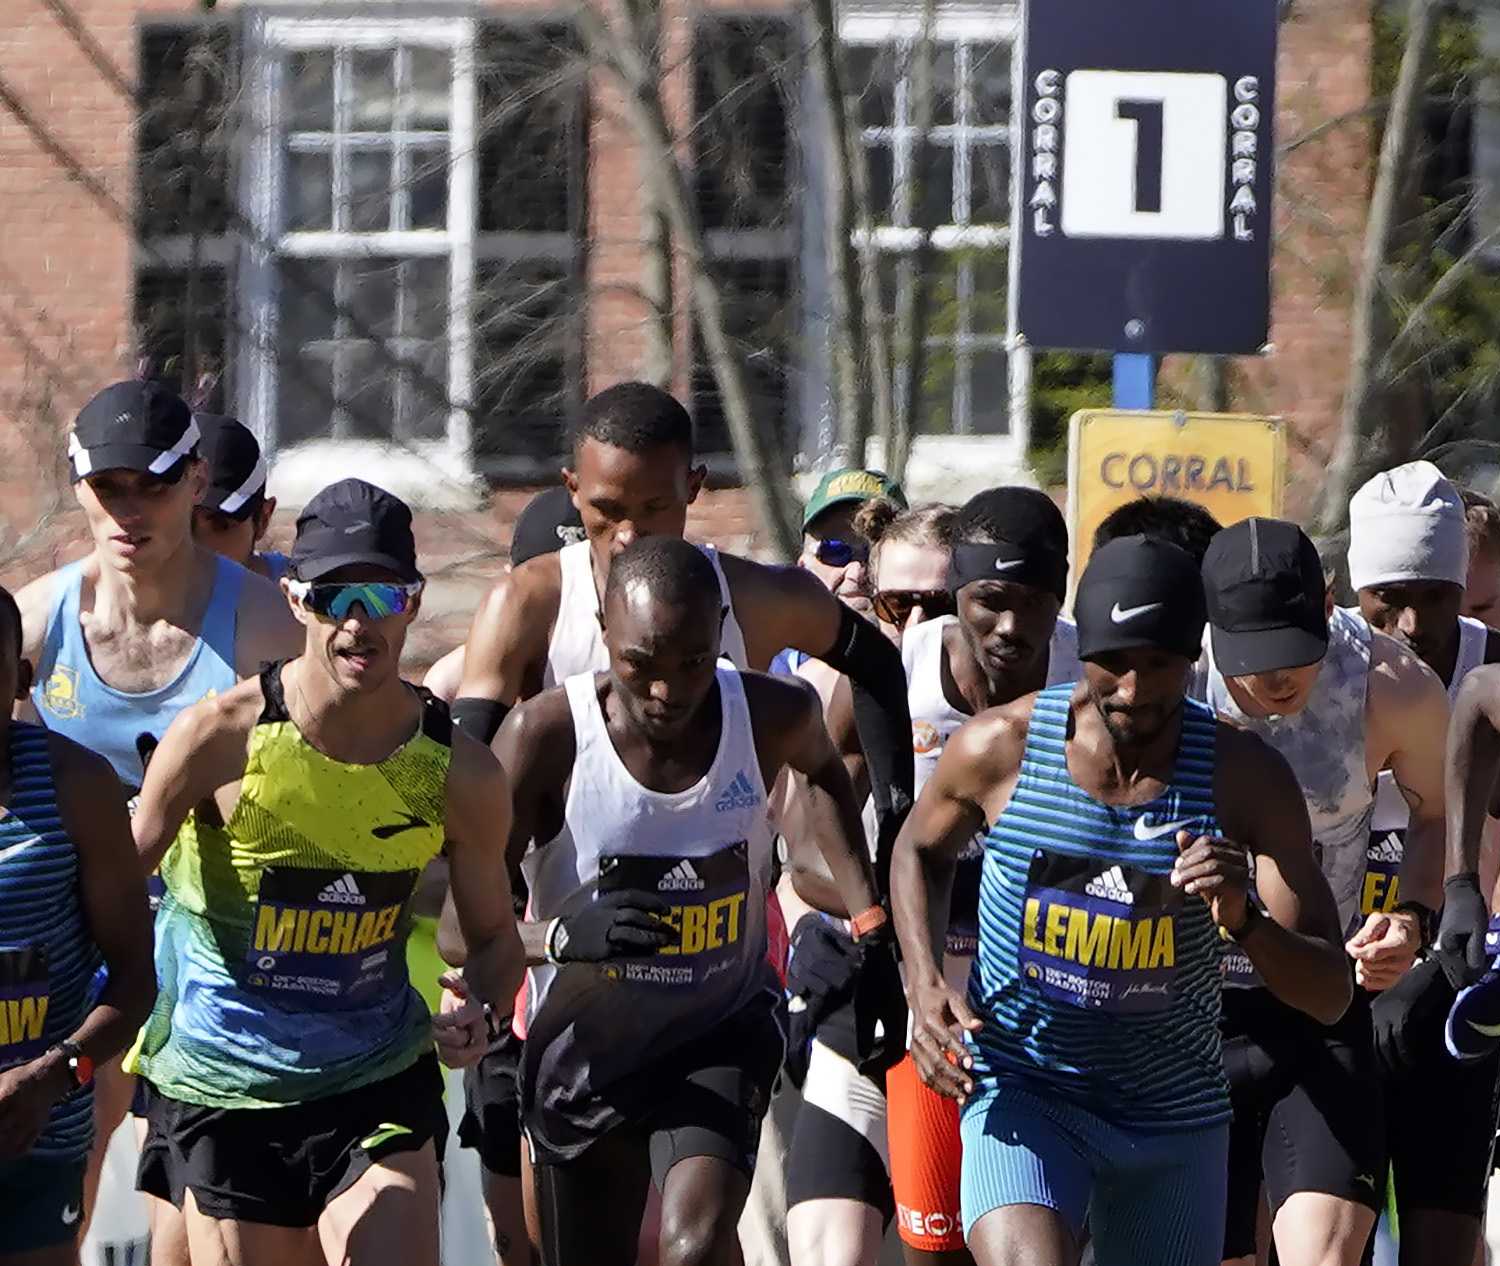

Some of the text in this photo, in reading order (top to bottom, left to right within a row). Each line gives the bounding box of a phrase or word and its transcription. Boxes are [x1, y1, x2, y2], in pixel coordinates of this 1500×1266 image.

[1029, 69, 1062, 238] CORRAL
[1113, 98, 1166, 214] 1
[1229, 75, 1261, 242] CORRAL
[1100, 451, 1256, 494] CORRAL
[254, 904, 401, 955] MICHAEL
[1023, 897, 1175, 971] LEMMA
